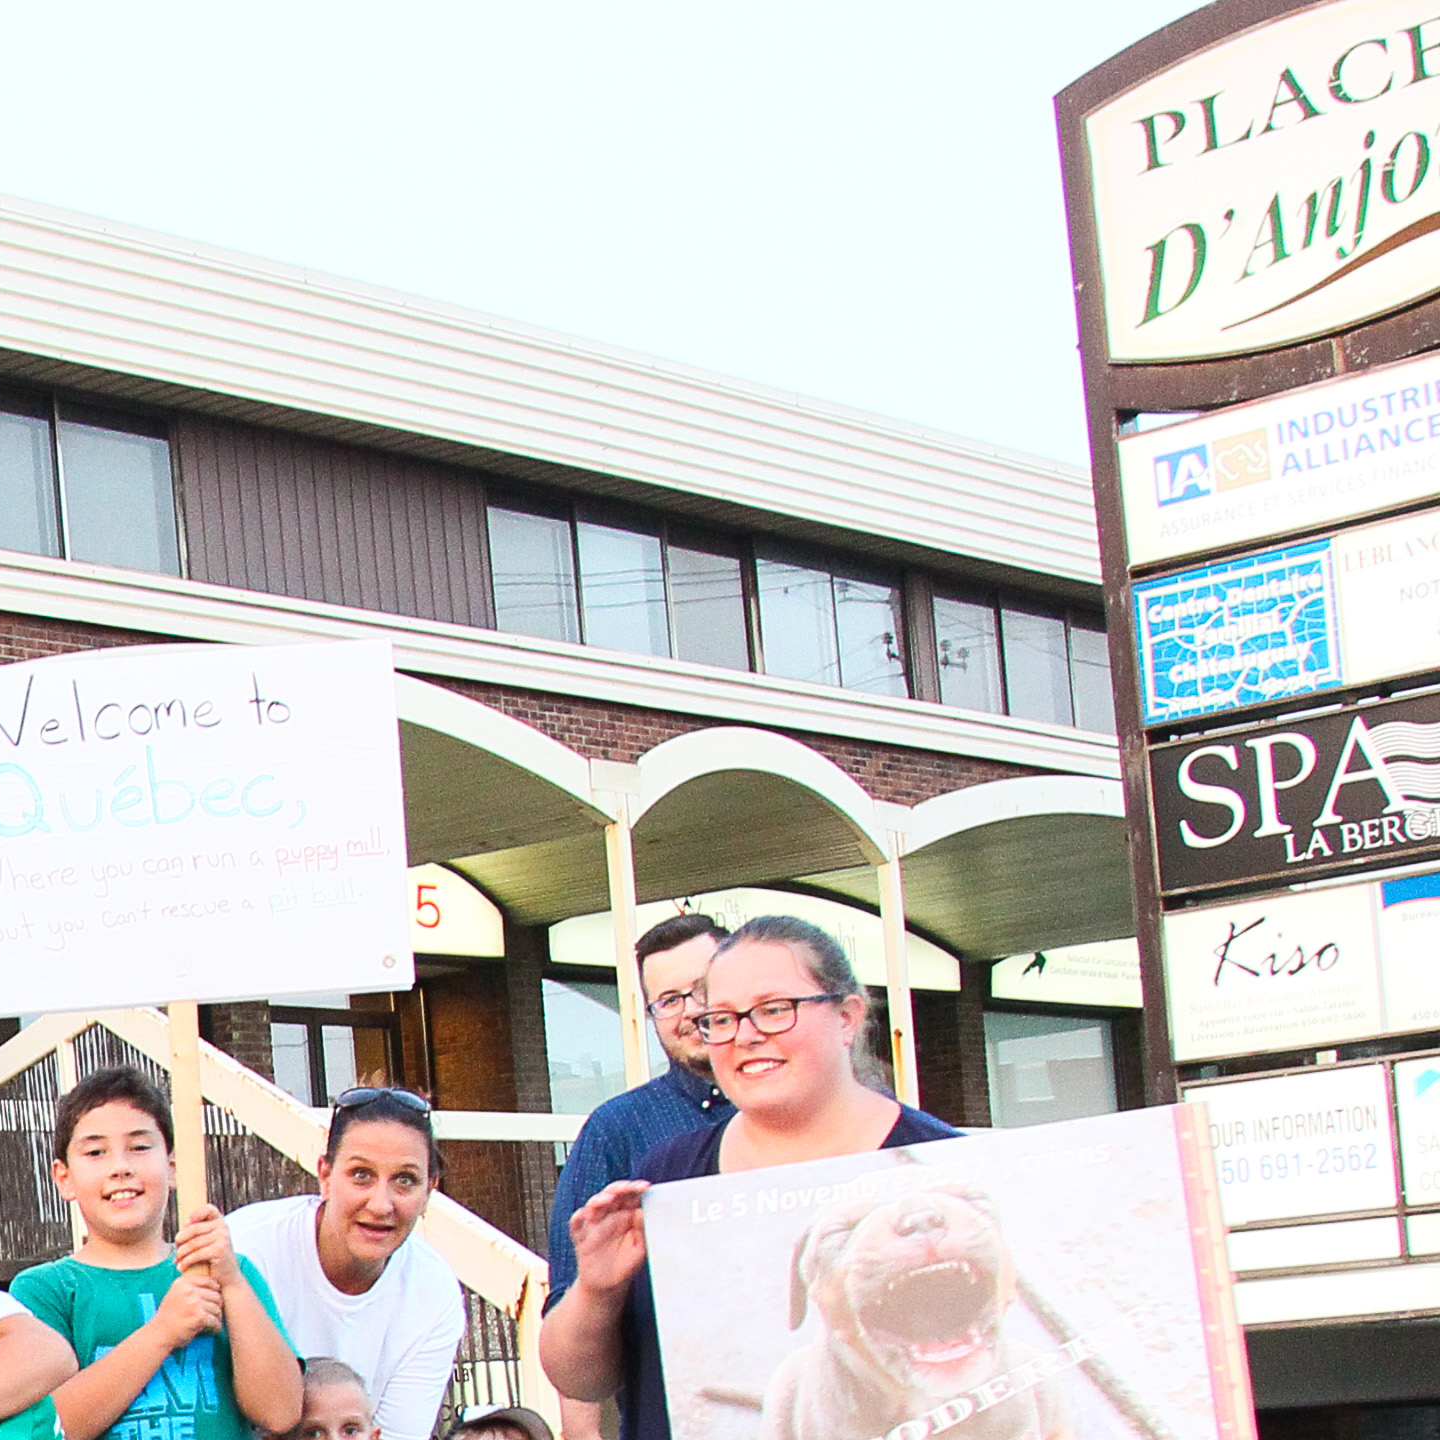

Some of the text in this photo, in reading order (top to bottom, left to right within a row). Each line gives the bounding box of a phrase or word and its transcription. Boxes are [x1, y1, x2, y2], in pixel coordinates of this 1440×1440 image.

[1135, 130, 1440, 329] D'Anjo
[1288, 474, 1366, 506] SERVICES
[1373, 453, 1440, 484] FINANC
[249, 671, 292, 726] to
[1178, 715, 1419, 849] SPA
[90, 858, 133, 899] you
[142, 852, 183, 876] can
[190, 848, 236, 874] run
[249, 848, 265, 867] a
[275, 843, 339, 878] puppy
[1283, 829, 1333, 863] LA
[45, 917, 86, 952] you
[160, 896, 232, 919] rescue
[241, 896, 255, 912] a
[267, 883, 302, 917] pit
[1213, 916, 1339, 986] Kiso
[1209, 1103, 1379, 1149] OUR INFORMATION
[690, 1199, 723, 1225] Le
[732, 1192, 749, 1218] 5
[756, 1173, 908, 1215] Novembre
[1021, 1142, 1113, 1173] crions
[1221, 1143, 1379, 1185] 50 691-2562
